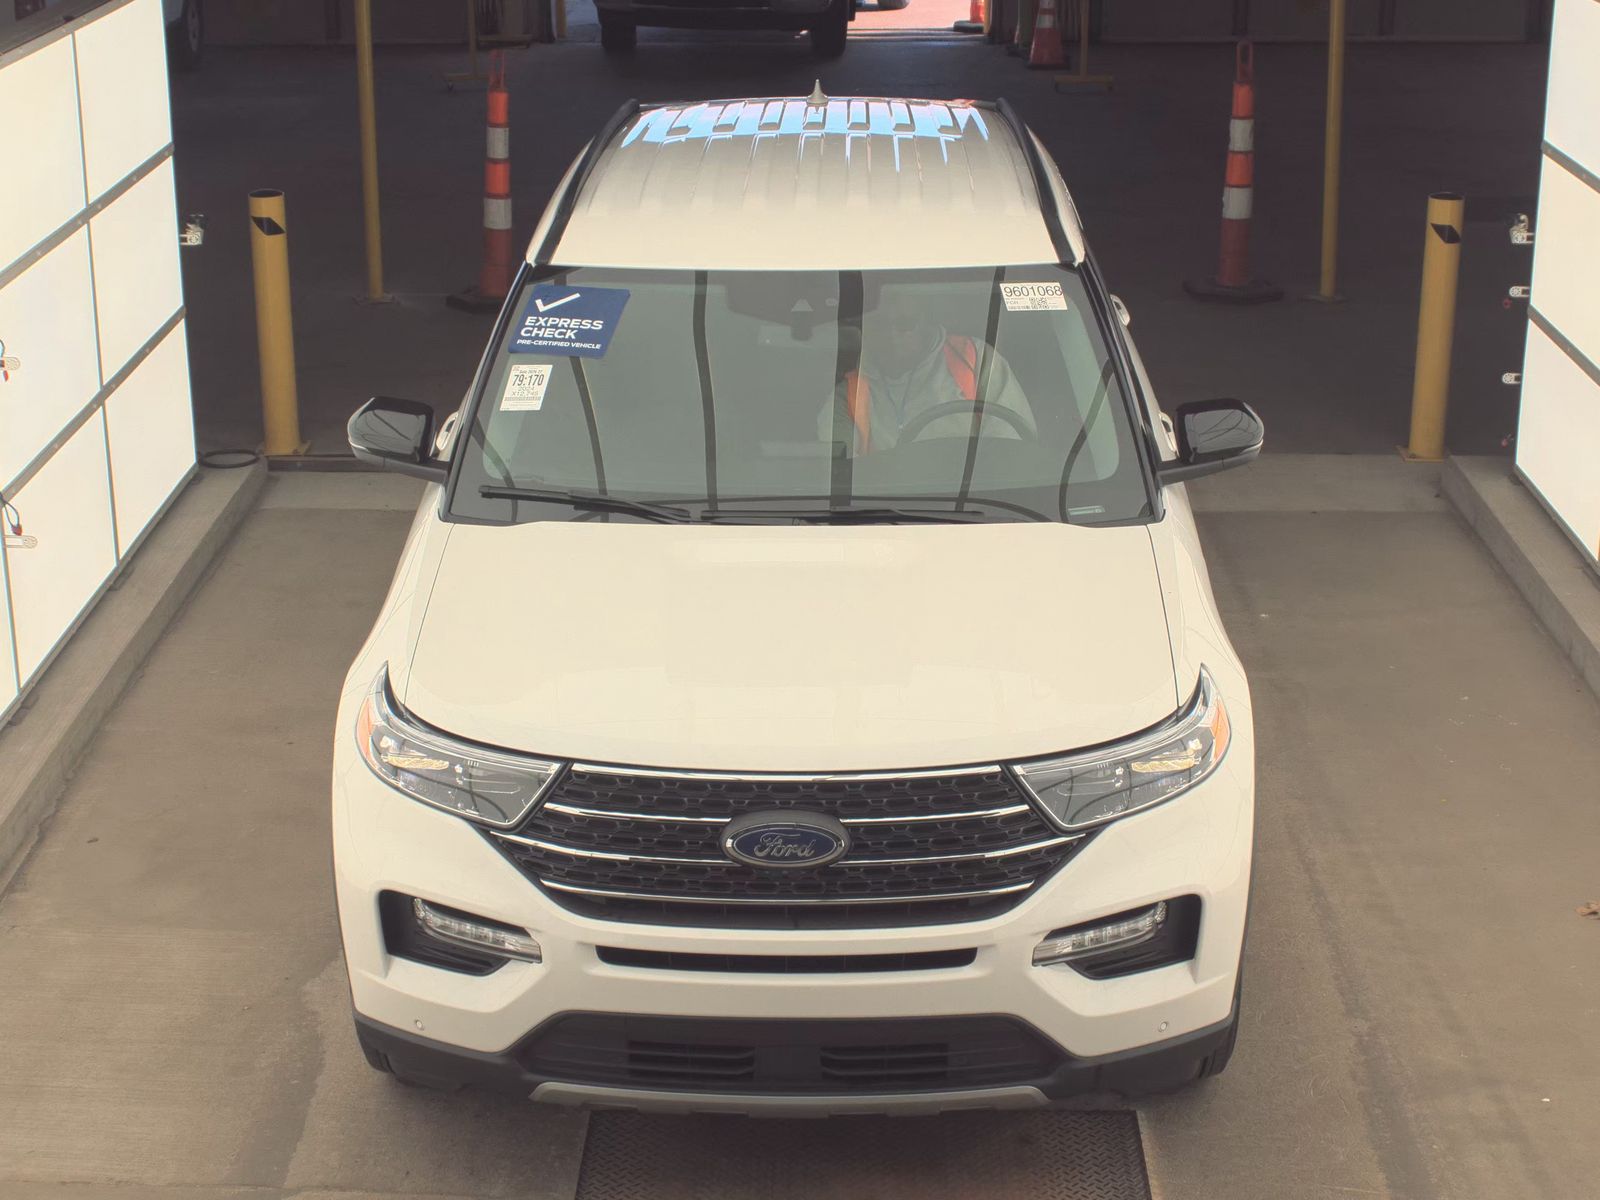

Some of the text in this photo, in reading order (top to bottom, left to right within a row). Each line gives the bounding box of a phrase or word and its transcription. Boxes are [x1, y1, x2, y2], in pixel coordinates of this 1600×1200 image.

[1003, 285, 1064, 297] 9601068
[525, 316, 604, 330] EXPRESS
[520, 327, 578, 339] CHECK
[517, 339, 570, 347] PRE-CERTIFIED
[754, 833, 816, 857] Ford
